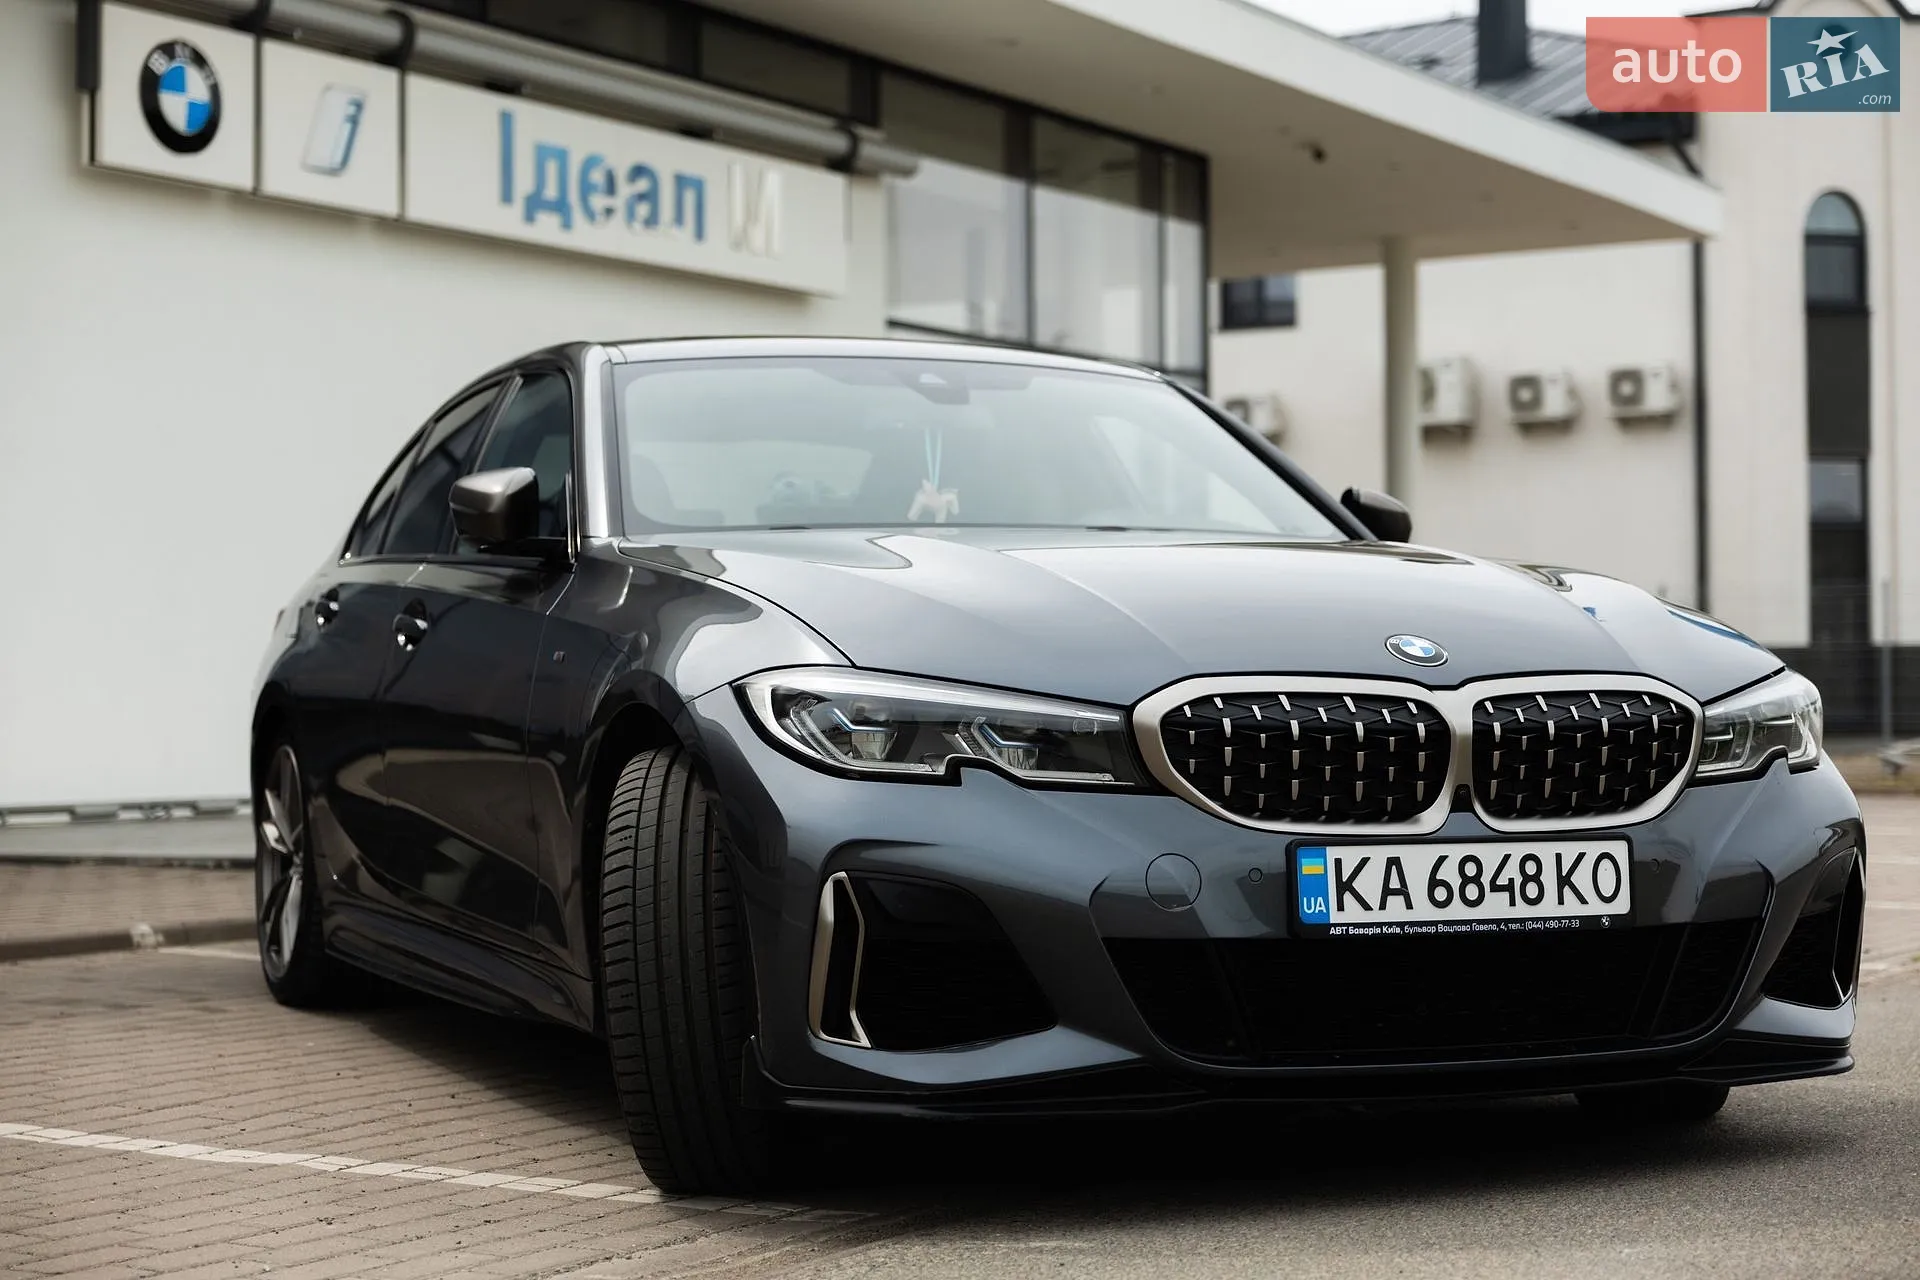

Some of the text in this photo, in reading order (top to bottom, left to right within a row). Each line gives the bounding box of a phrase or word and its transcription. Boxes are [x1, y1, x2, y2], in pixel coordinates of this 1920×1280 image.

[498, 108, 706, 244] Ідеал
[1334, 851, 1622, 912] KA 6848 KO
[1303, 896, 1327, 914] UA
[1348, 925, 1381, 936] Баварія
[1404, 924, 1436, 935] бульвар
[1525, 921, 1544, 930] (044)
[1545, 919, 1580, 929] 490-77-33
